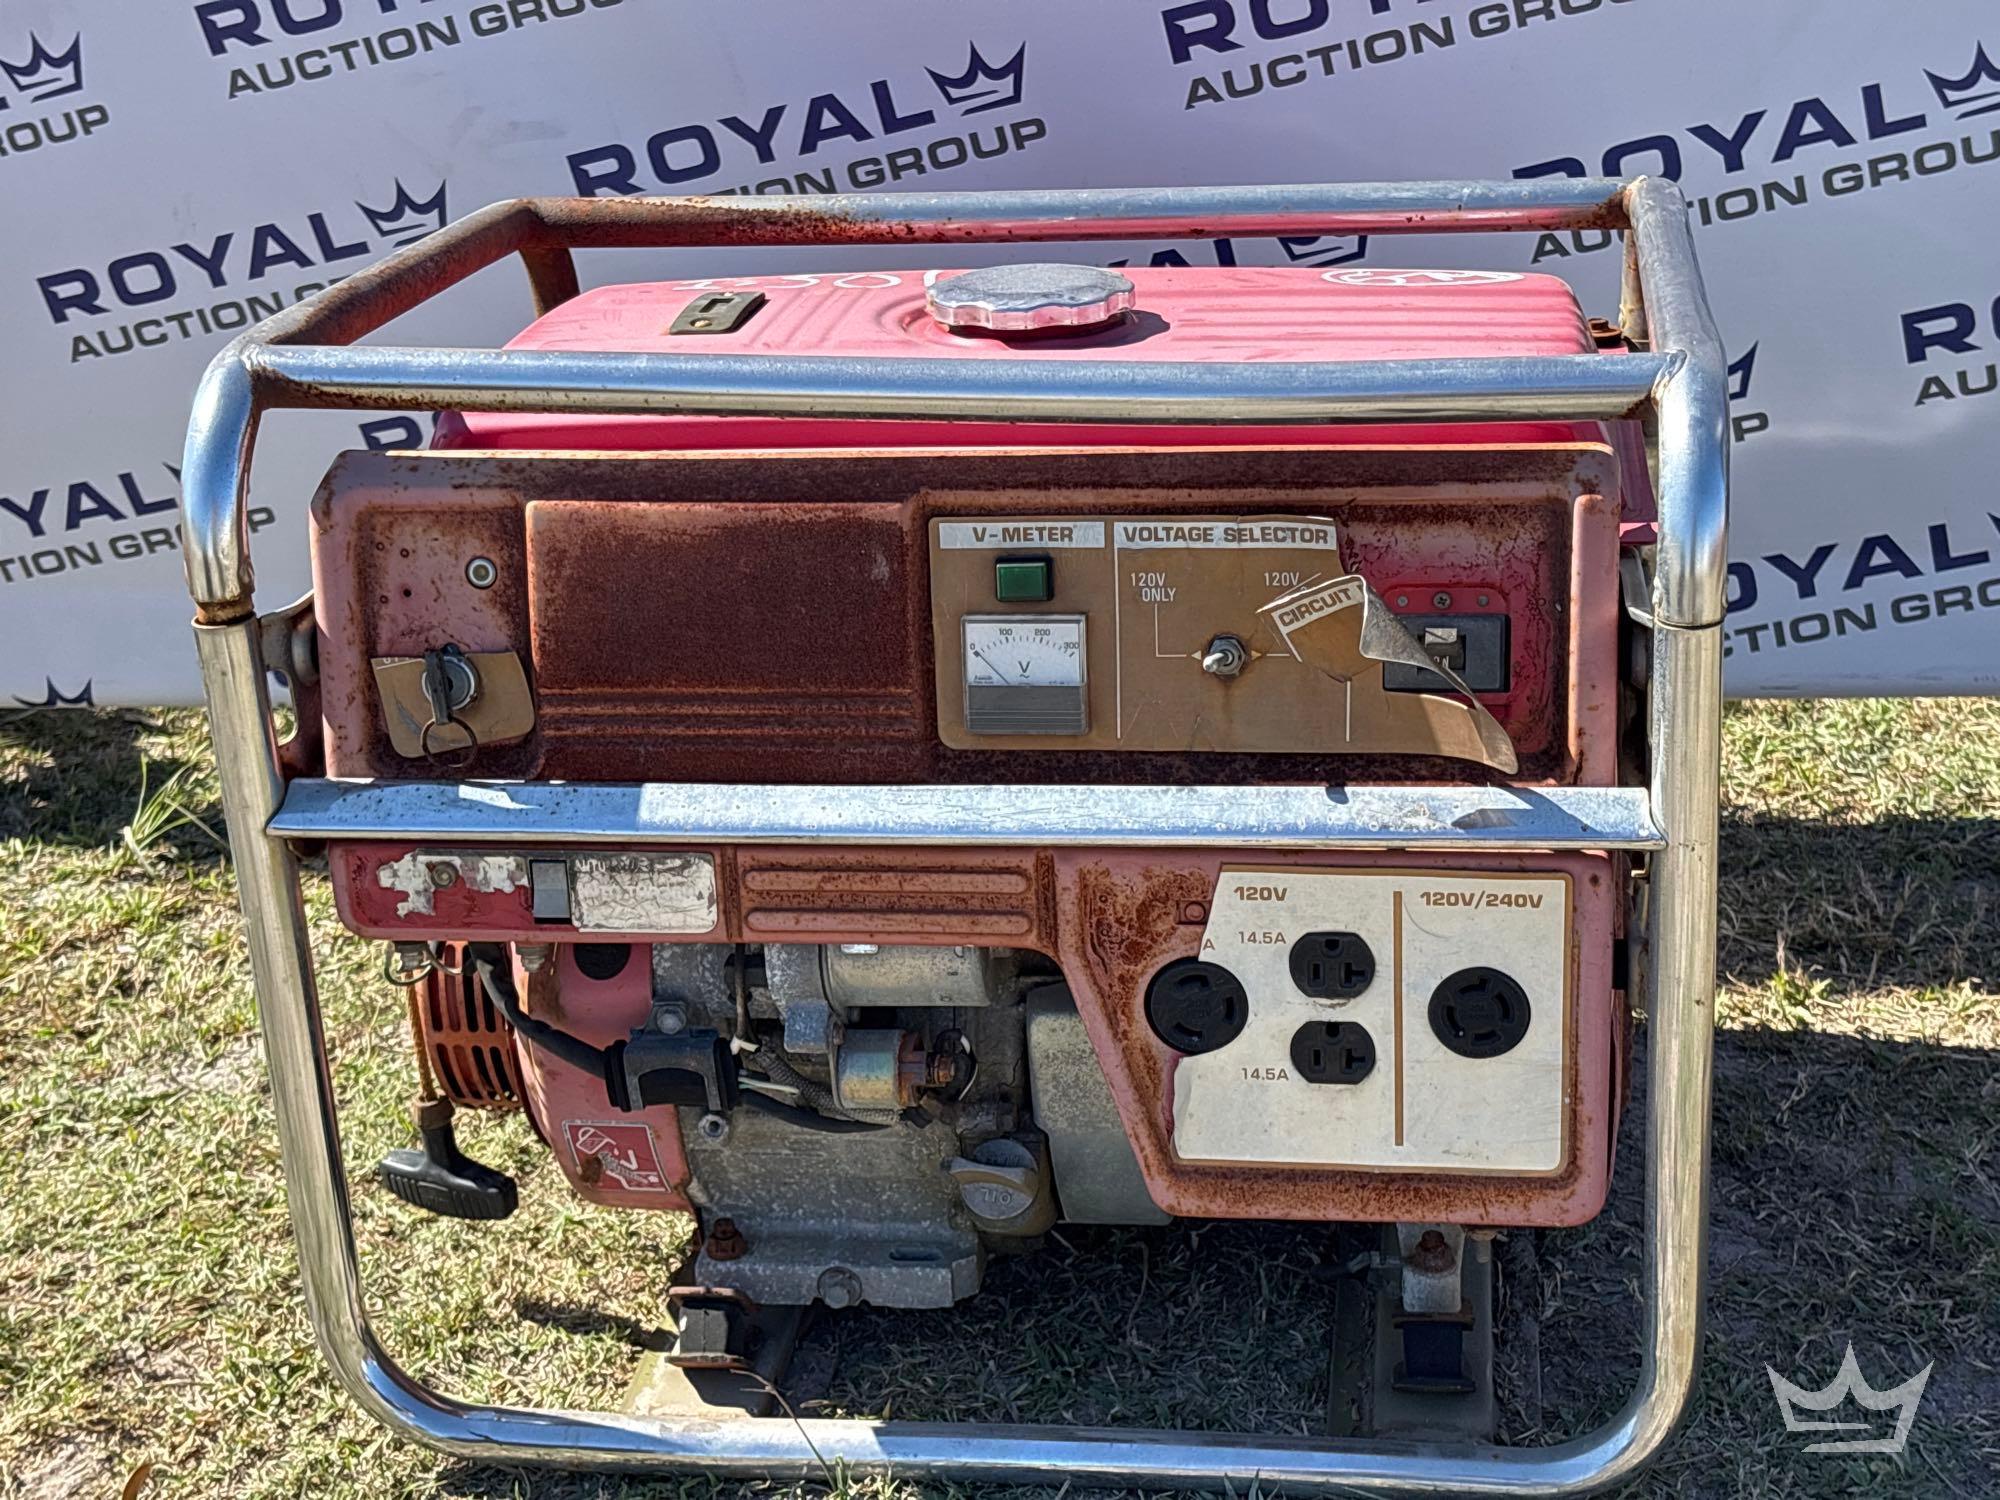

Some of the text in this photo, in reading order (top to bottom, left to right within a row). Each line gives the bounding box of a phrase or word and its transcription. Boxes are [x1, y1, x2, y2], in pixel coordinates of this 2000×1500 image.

[229, 15, 460, 99] AUCTION
[1185, 16, 1456, 110] AUCTION
[567, 79, 936, 197] ROYAL
[847, 118, 1046, 190] GROUP
[1530, 176, 1807, 264] AUION
[36, 212, 371, 324] ROYAL
[70, 291, 284, 363] AUCTION
[109, 507, 275, 560] GRP
[972, 526, 1074, 543] V-METER
[1123, 526, 1328, 545] VOLTAGE SELECTOR
[1131, 572, 1166, 587] 120V
[1264, 572, 1299, 586] 120V
[1142, 588, 1176, 602] ONLY
[1278, 588, 1351, 628] CIRCUIT
[999, 628, 1050, 636] 100 200
[1723, 603, 1877, 658] TION
[969, 642, 1080, 651] 0 300
[1018, 661, 1031, 674] V
[1234, 886, 1543, 909] 120V 120V/240V
[1238, 931, 1287, 945] 14.5A
[1242, 1067, 1289, 1081] 14.5A
